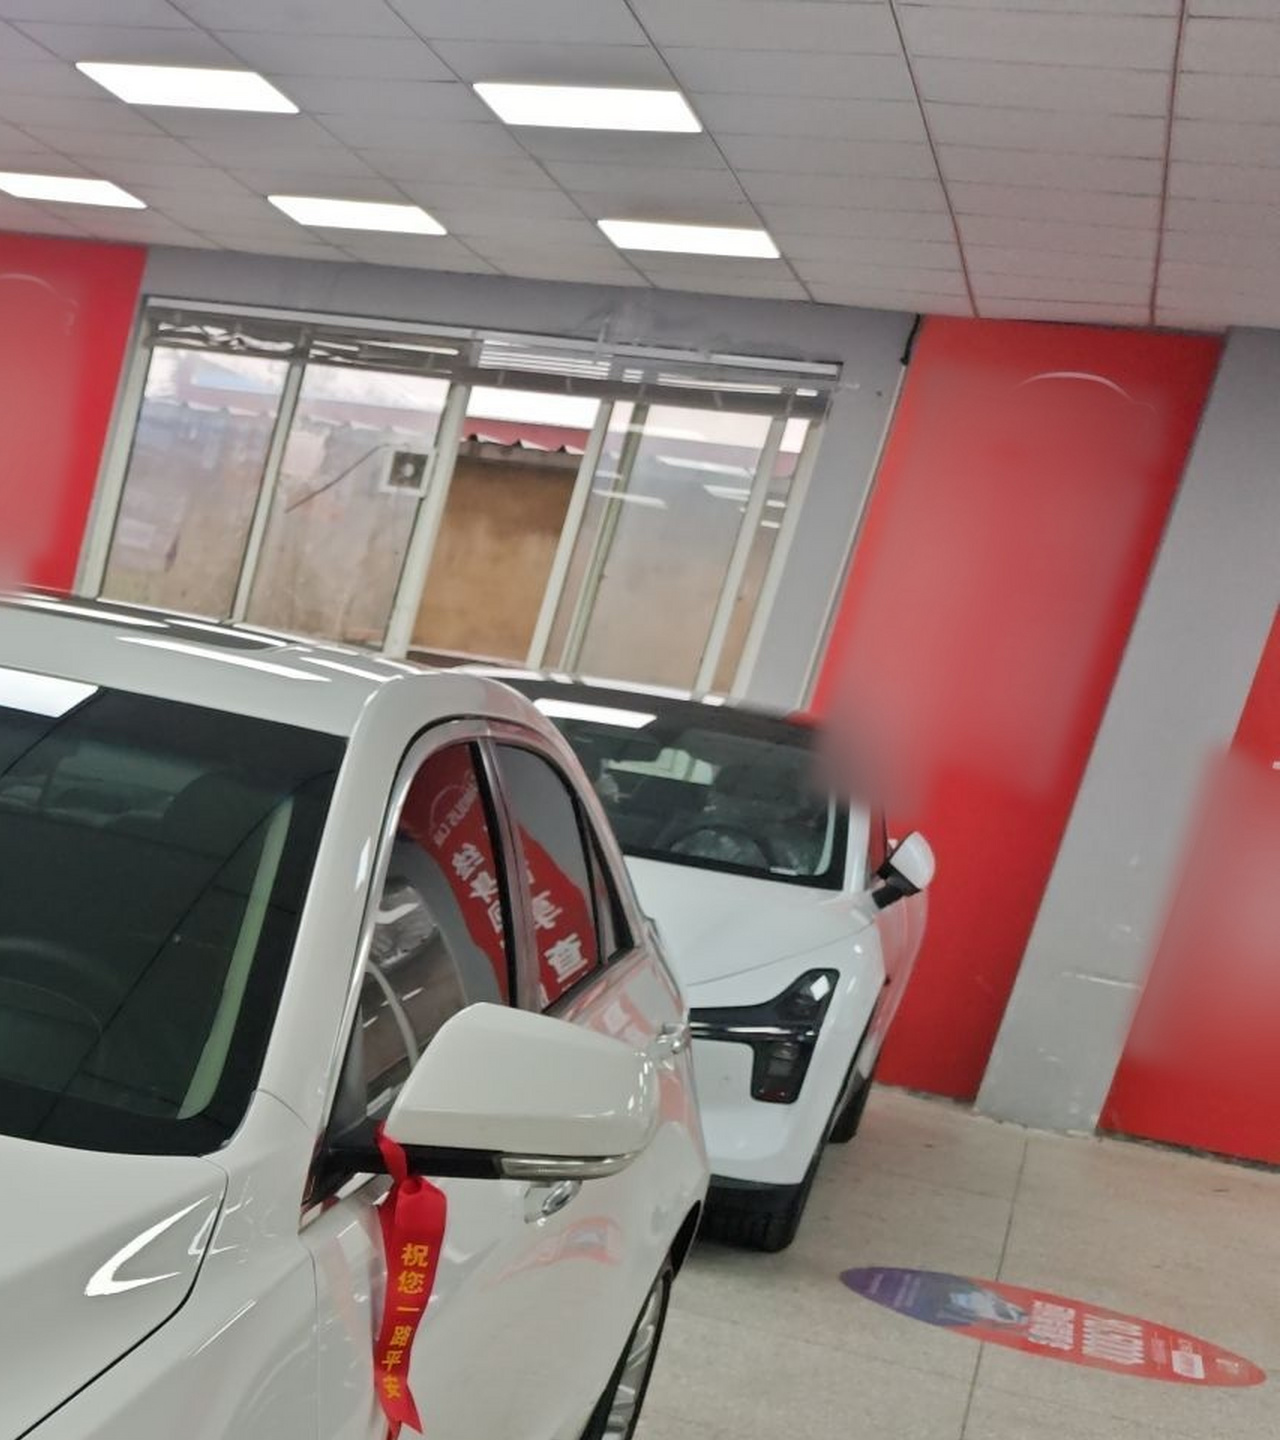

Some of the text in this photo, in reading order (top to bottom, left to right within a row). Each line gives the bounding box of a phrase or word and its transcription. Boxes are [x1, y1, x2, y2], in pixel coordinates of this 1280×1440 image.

[381, 1243, 429, 1399] 祝您一路平安
